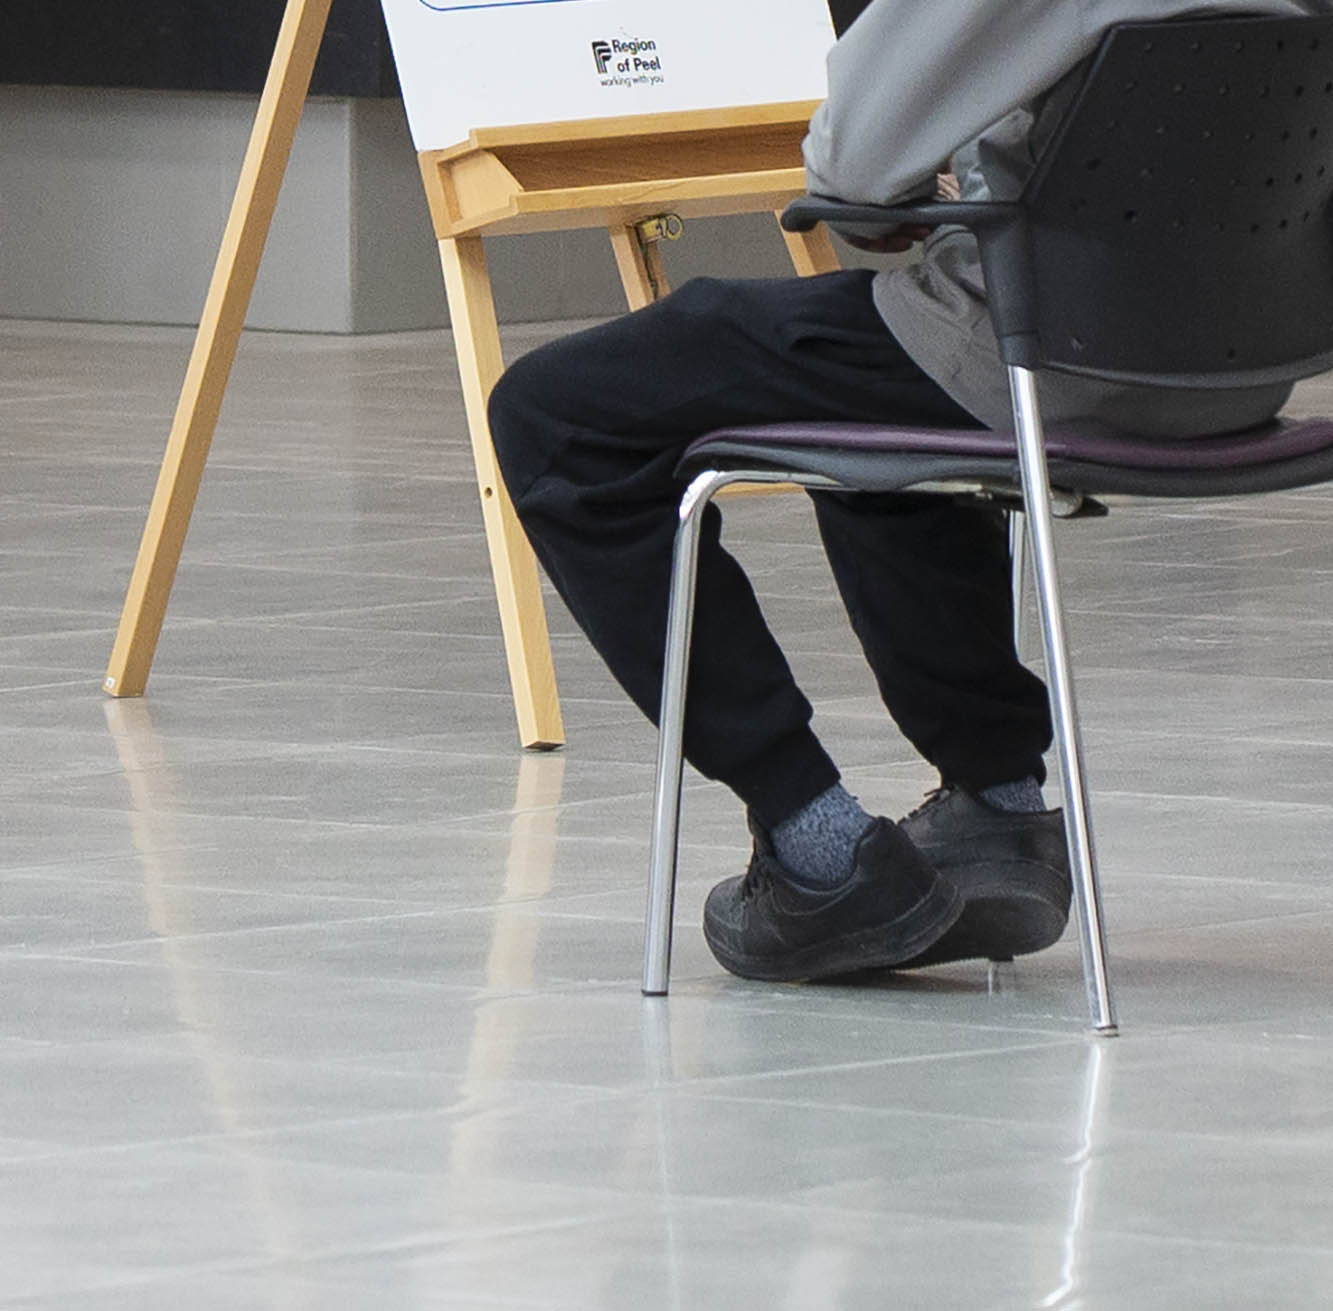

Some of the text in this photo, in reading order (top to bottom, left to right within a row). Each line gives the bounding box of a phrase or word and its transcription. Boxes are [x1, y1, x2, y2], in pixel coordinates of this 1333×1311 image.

[611, 37, 657, 55] Region
[617, 55, 662, 73] of Peel
[600, 75, 665, 88] working with you
